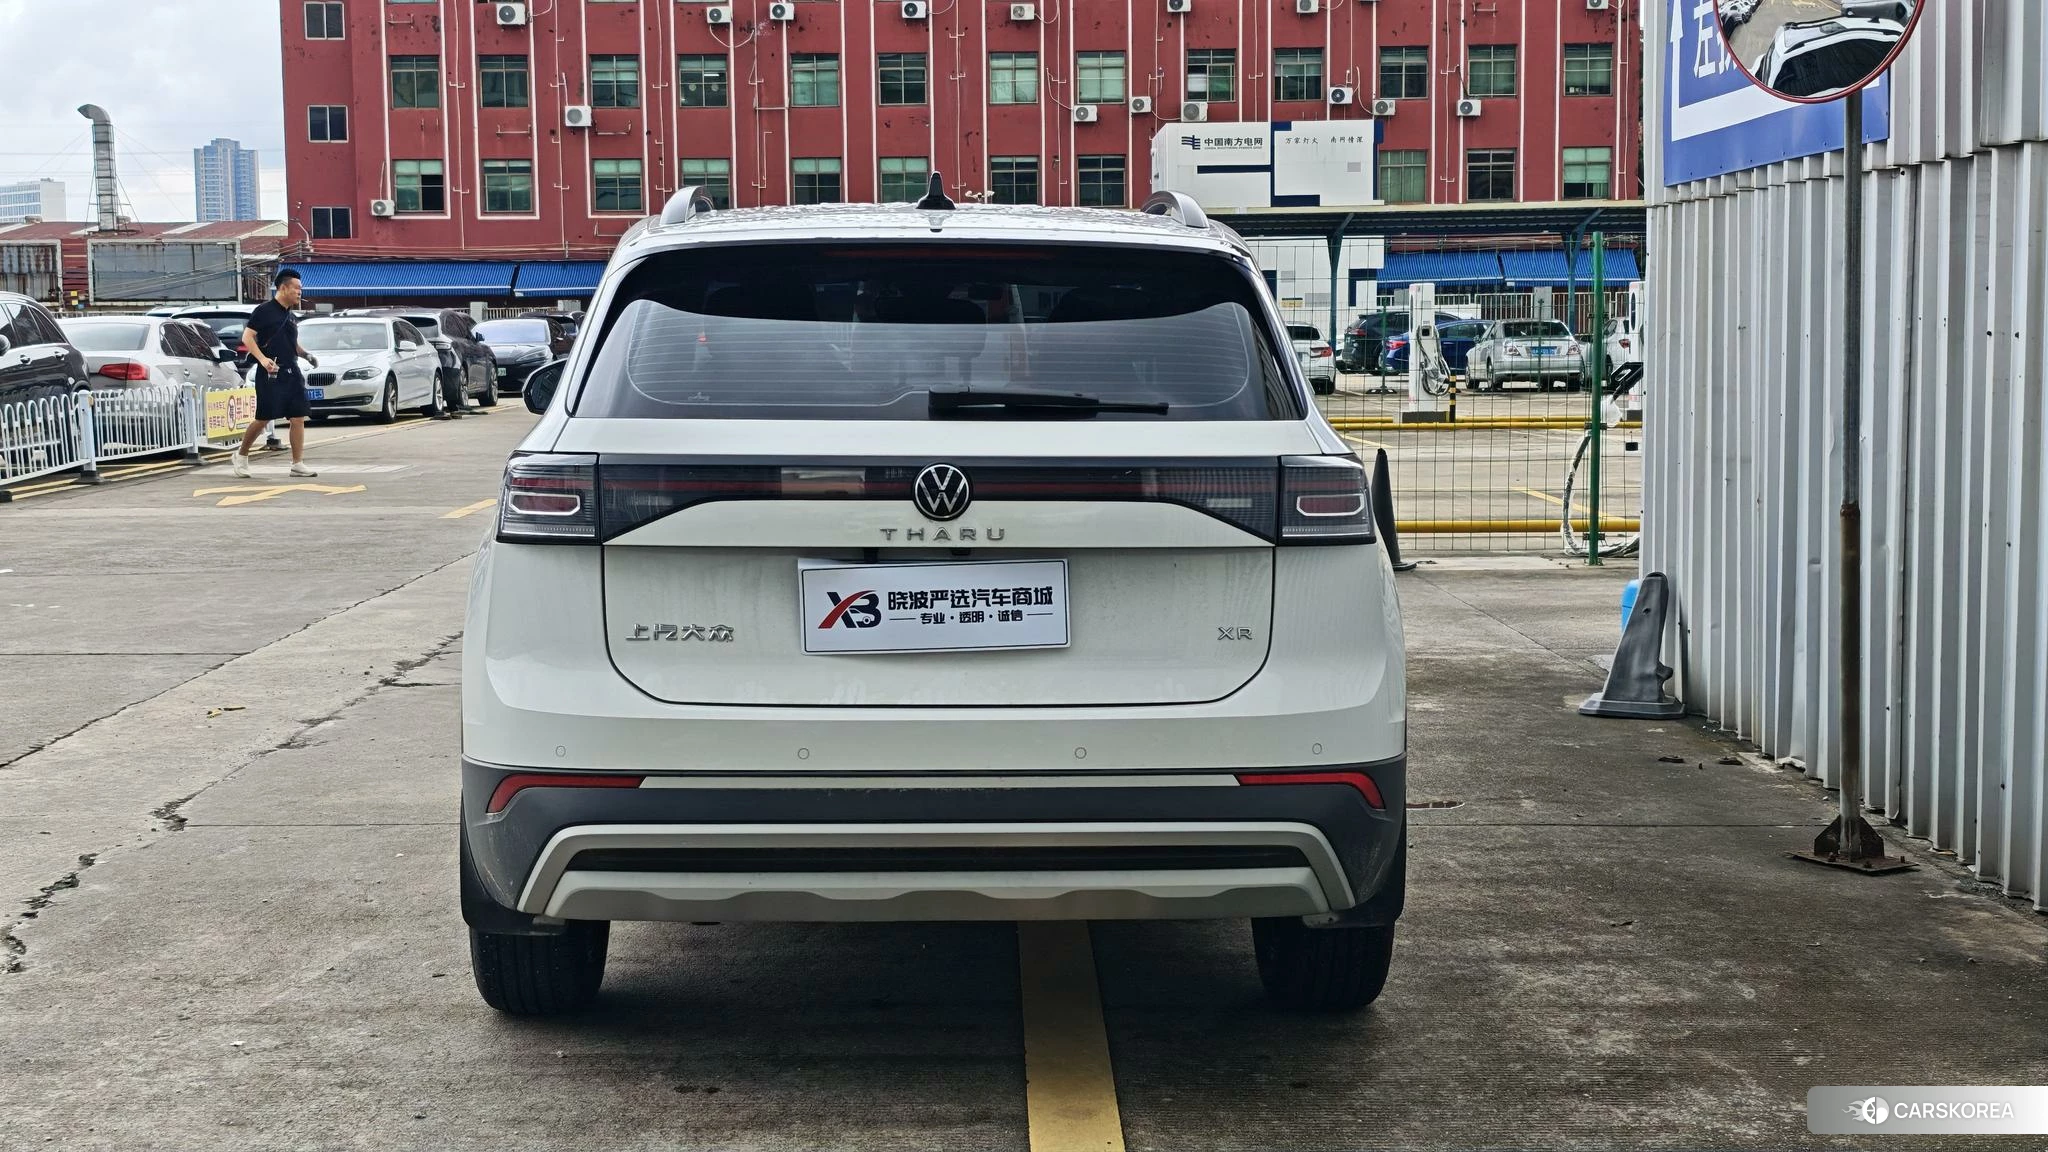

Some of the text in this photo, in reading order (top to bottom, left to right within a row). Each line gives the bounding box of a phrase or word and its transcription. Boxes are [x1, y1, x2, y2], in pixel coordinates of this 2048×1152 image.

[1204, 137, 1263, 146] 中国南方电网
[880, 527, 1005, 541] THARU
[887, 585, 1054, 611] 晓波严选汽车商城
[625, 623, 735, 642] 上汽大众
[1217, 626, 1253, 641] XR
